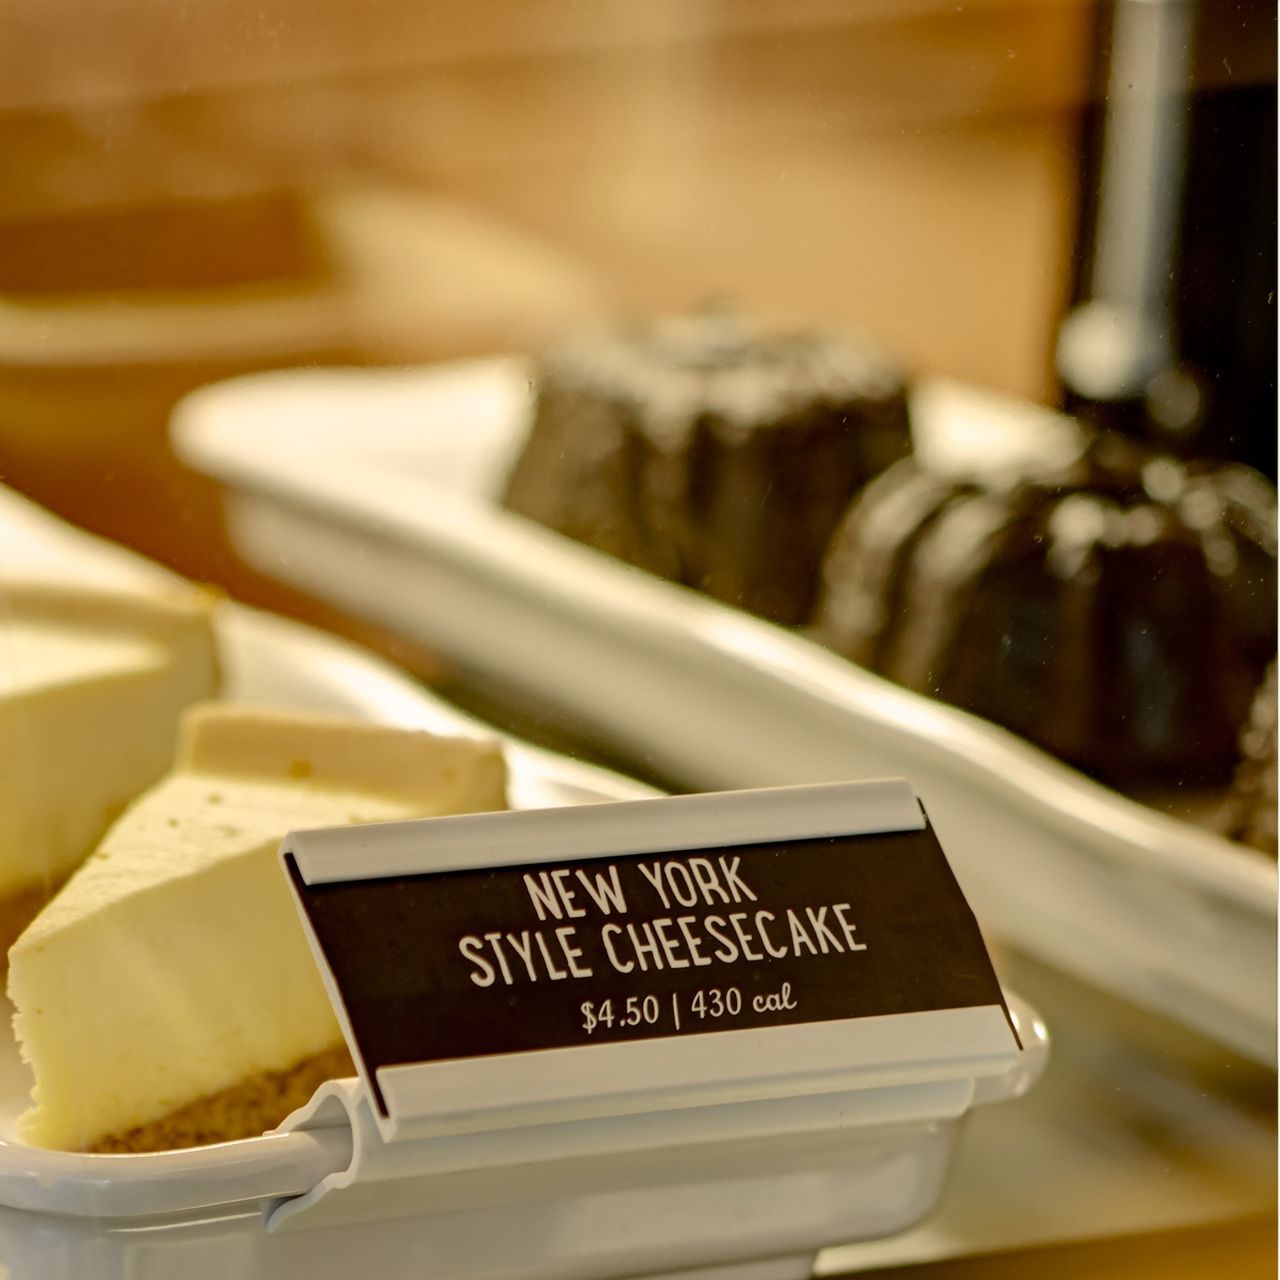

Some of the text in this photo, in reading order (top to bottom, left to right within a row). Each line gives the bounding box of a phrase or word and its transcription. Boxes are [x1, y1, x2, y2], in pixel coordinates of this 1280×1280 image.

[523, 856, 757, 921] NEW YORK
[458, 903, 868, 988] STYLE CHEESECAKE
[580, 993, 660, 1034] $4.50
[690, 988, 743, 1020] 430
[752, 982, 798, 1013] cal
